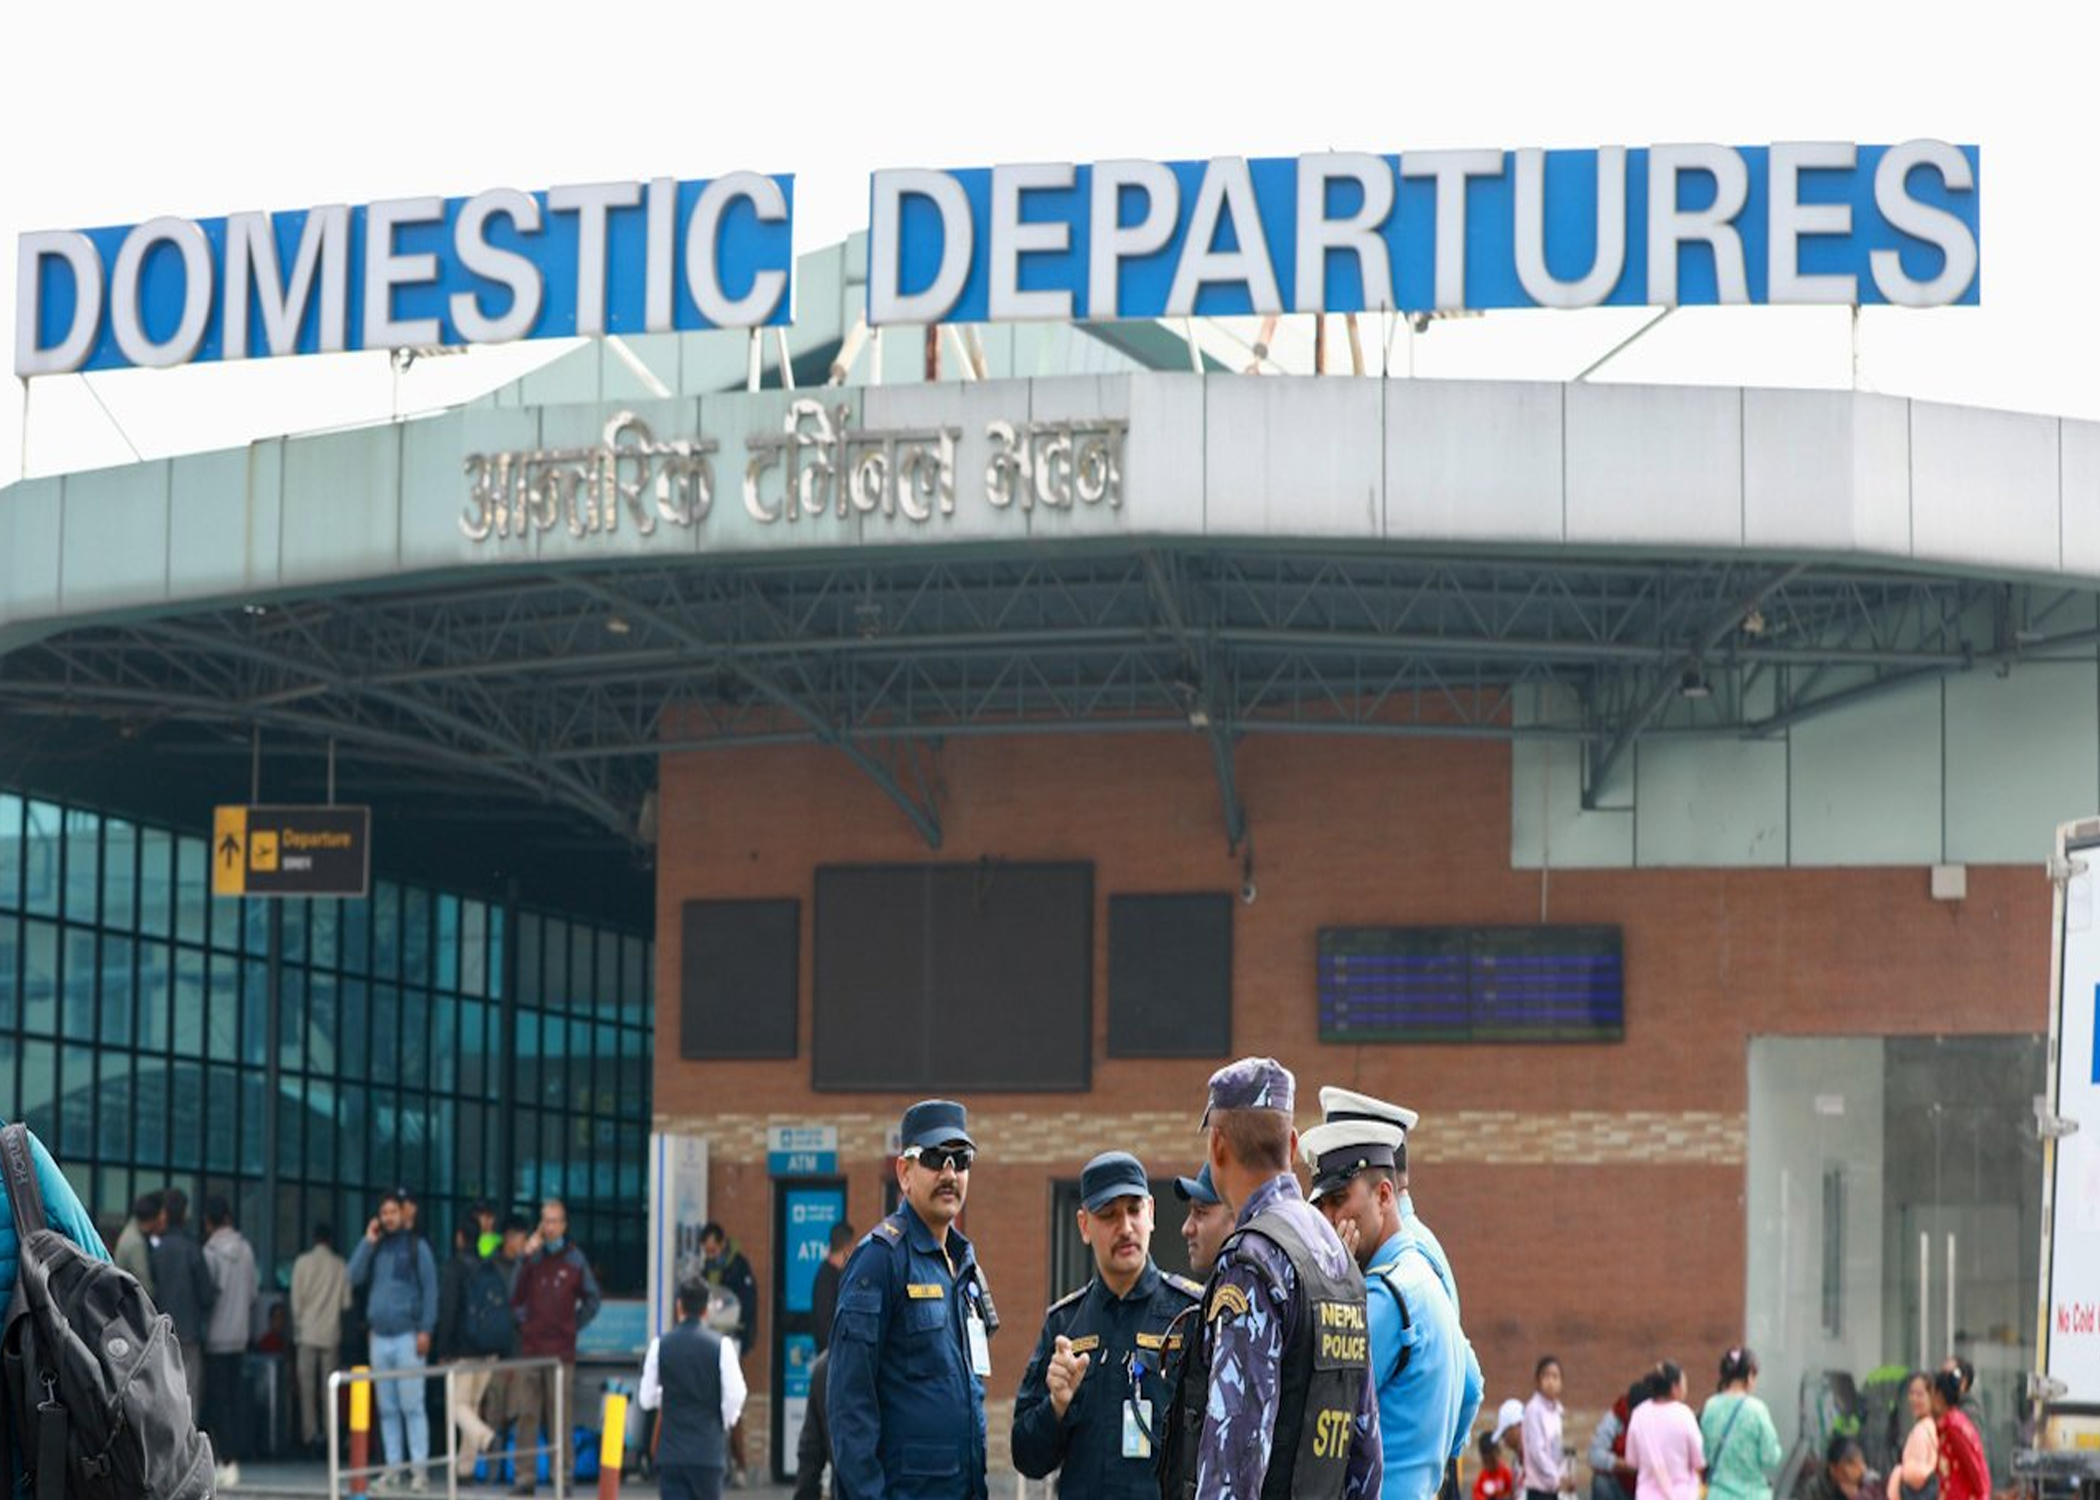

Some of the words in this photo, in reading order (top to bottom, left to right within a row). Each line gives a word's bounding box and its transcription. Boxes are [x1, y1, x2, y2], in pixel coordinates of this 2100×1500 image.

[14, 170, 788, 376] DOMESTIC
[870, 137, 1978, 325] DEPARTURES
[282, 829, 352, 849] Departure
[787, 1155, 817, 1172] ATM
[1320, 1302, 1365, 1329] NEPAL
[2056, 1303, 2070, 1333] No
[2073, 1302, 2095, 1333] Cold
[1321, 1333, 1366, 1361] POLICE
[1313, 1408, 1351, 1459] STF
